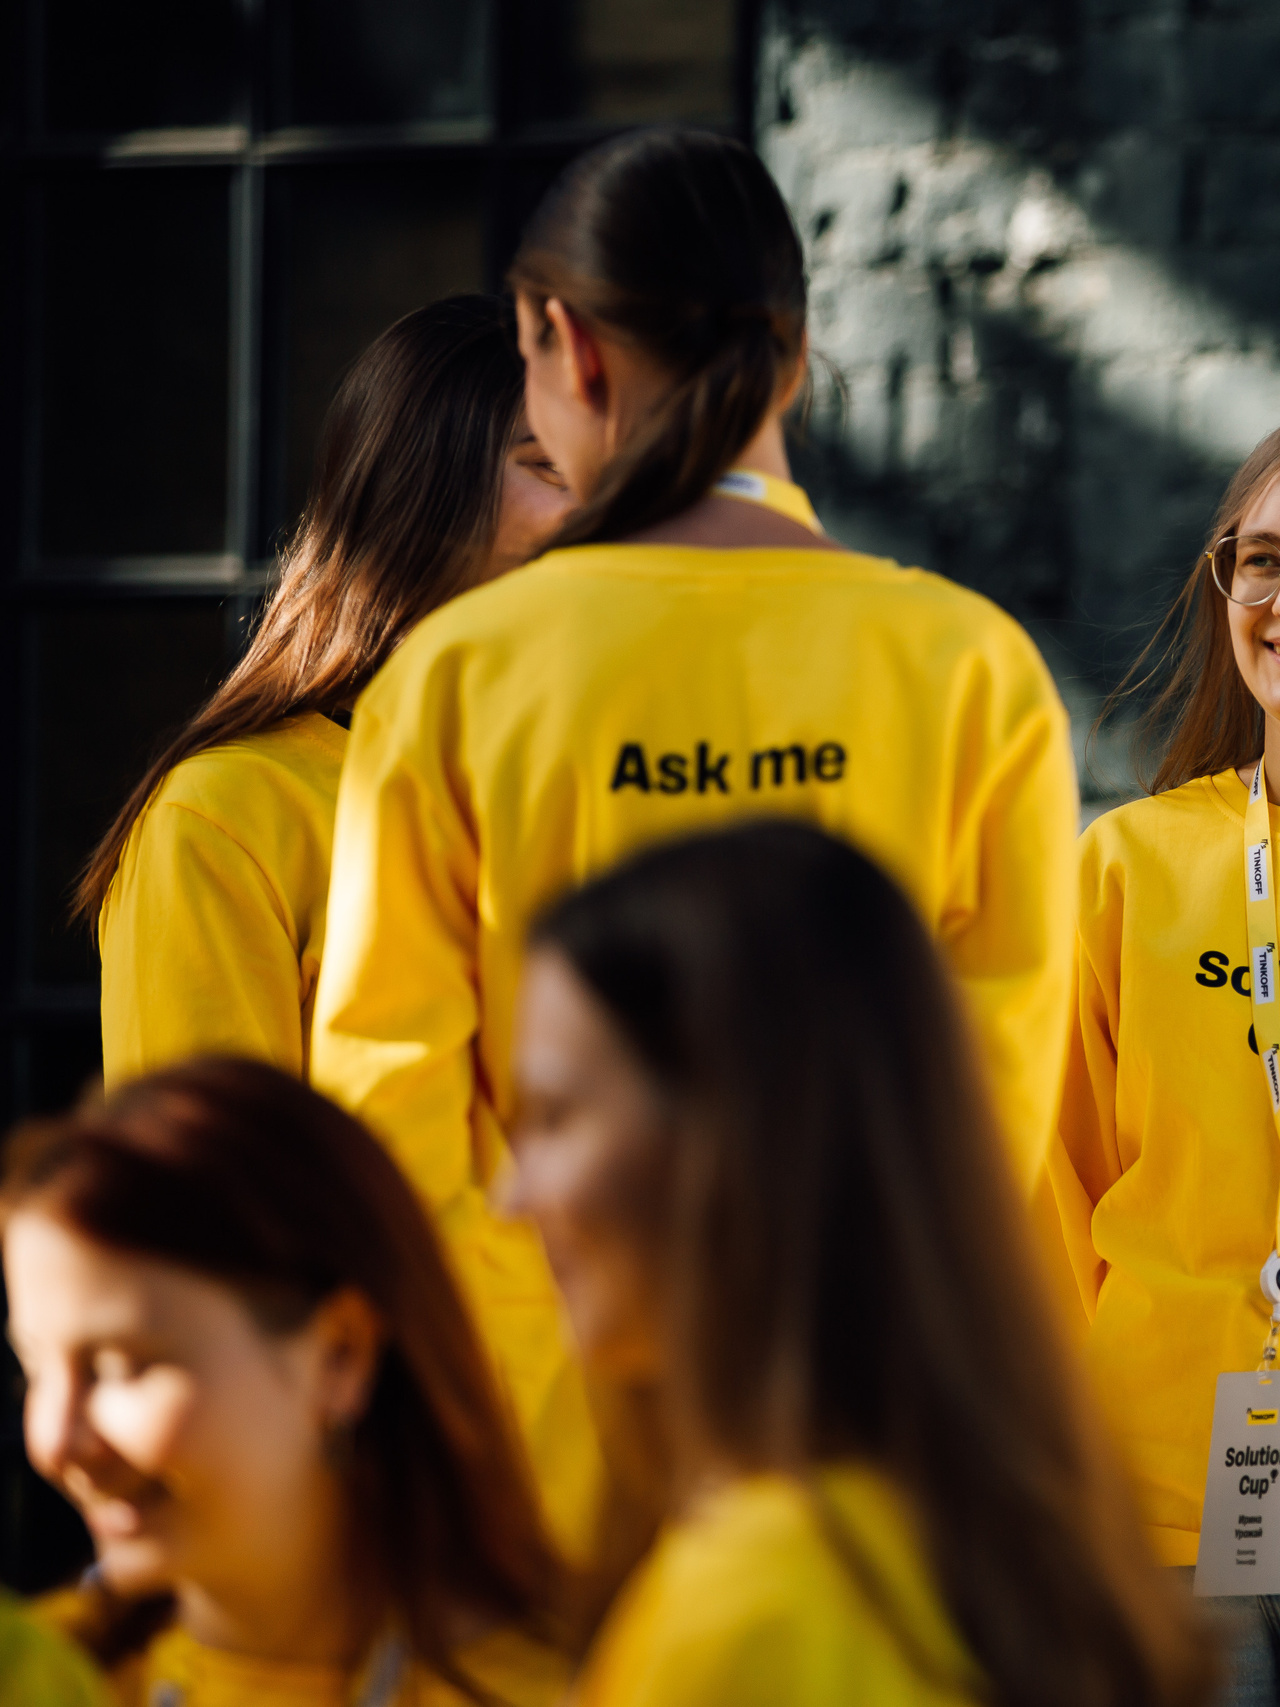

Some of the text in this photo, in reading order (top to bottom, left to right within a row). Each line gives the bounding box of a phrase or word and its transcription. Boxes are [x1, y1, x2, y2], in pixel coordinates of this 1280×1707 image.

[610, 741, 846, 795] Ask me
[1253, 849, 1263, 895] TINKOFF
[1259, 951, 1269, 998] TINKOFF
[1239, 1475, 1269, 1499] Cup
